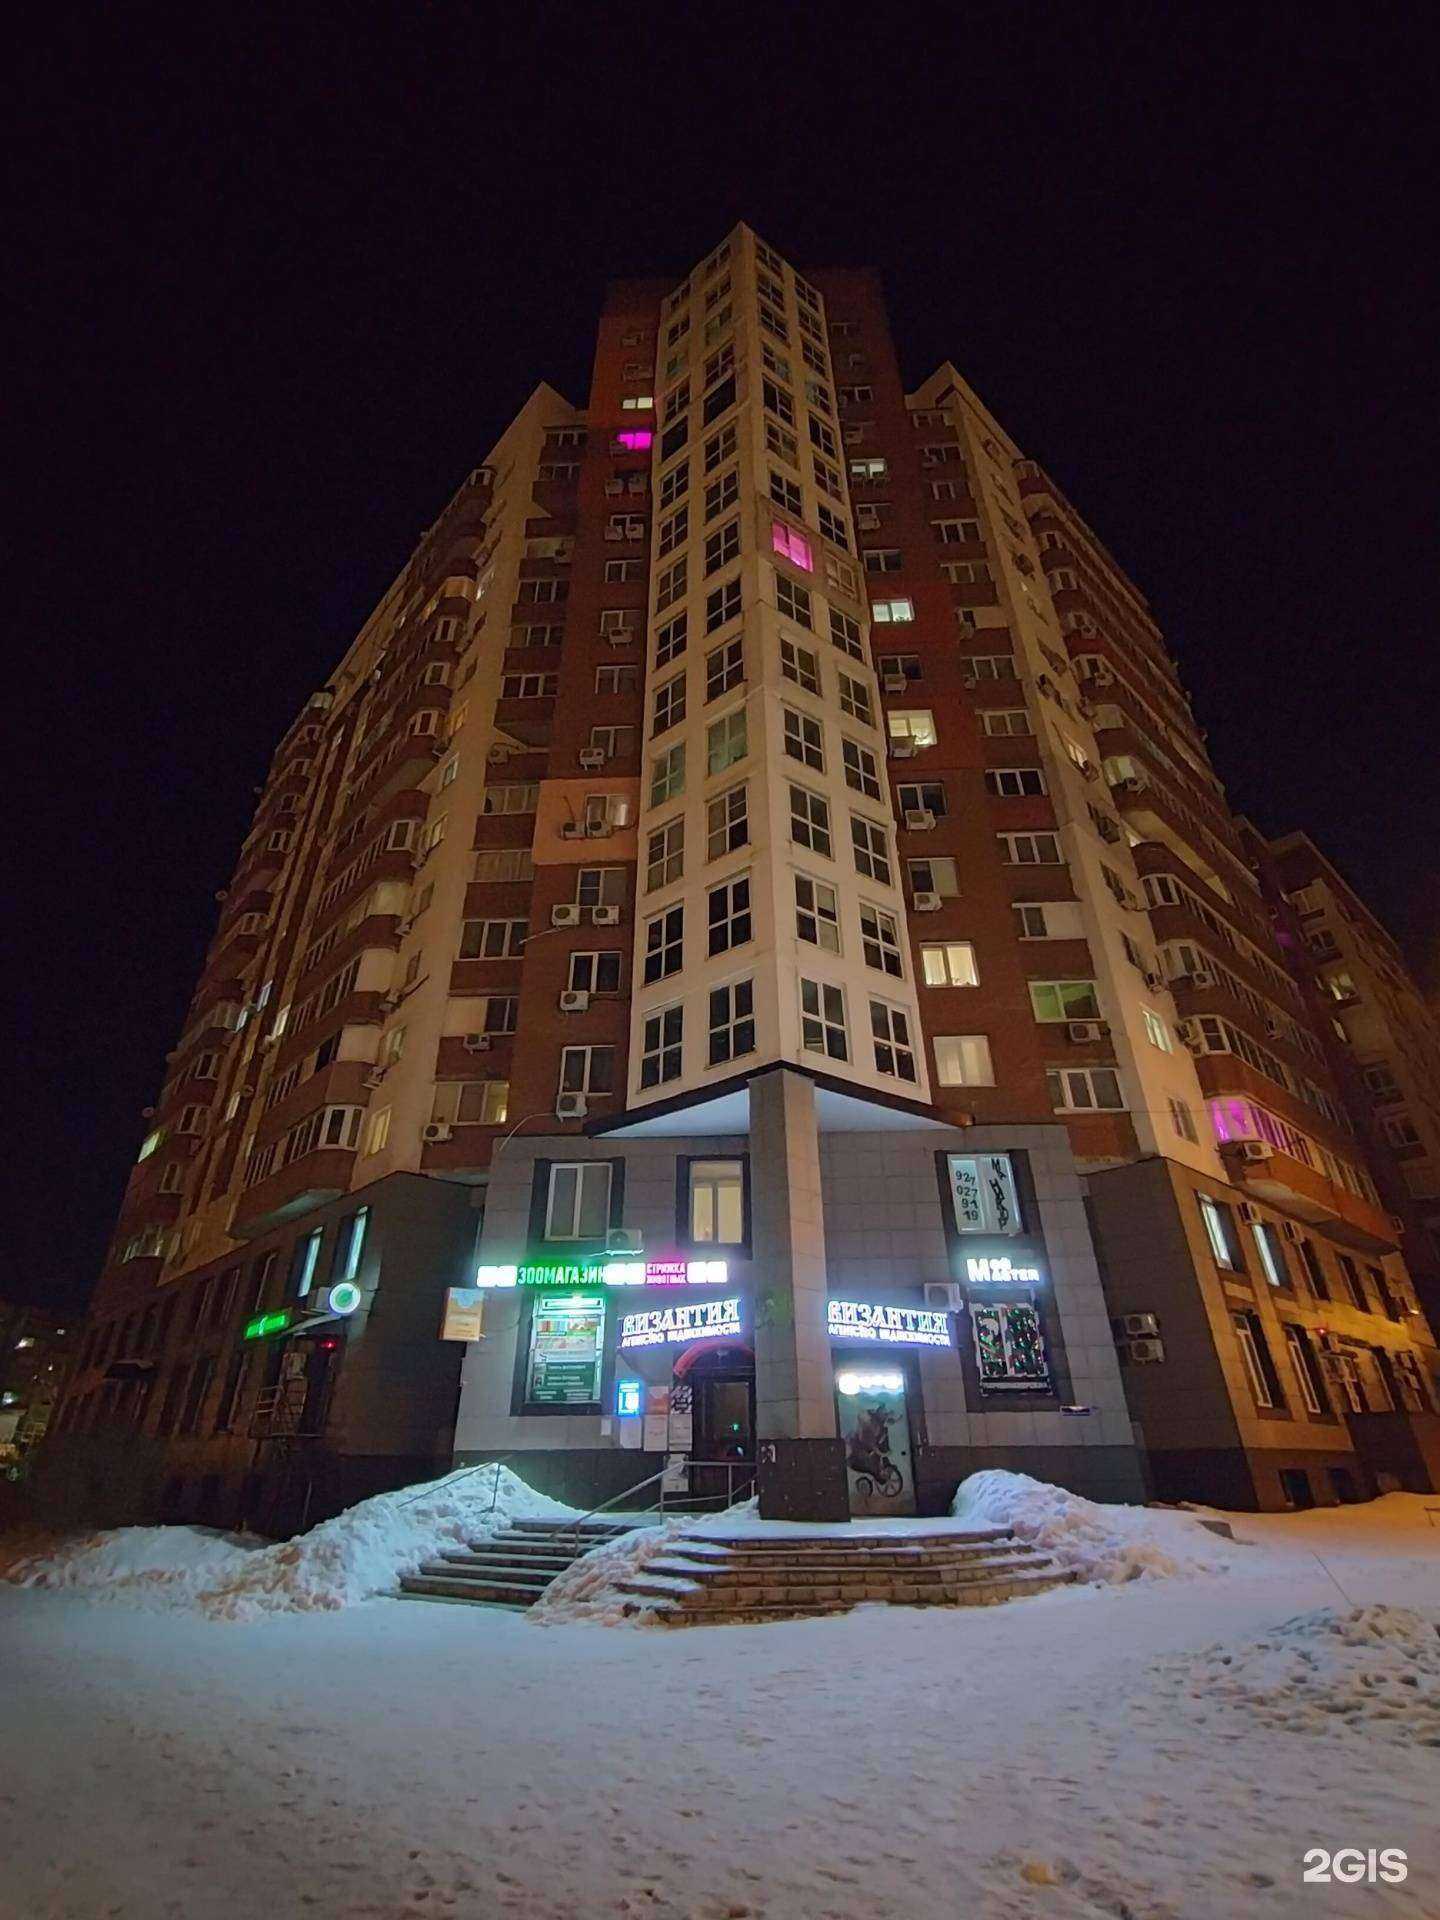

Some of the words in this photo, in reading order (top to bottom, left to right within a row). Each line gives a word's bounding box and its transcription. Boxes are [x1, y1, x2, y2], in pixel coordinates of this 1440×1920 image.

[517, 1266, 607, 1285] ЗООМАГАЗИН
[646, 1263, 686, 1275] СТРИЖКА
[621, 1298, 741, 1337] ВИЗАНТИЯ
[827, 1301, 949, 1335] ВИЗАНТИЯ
